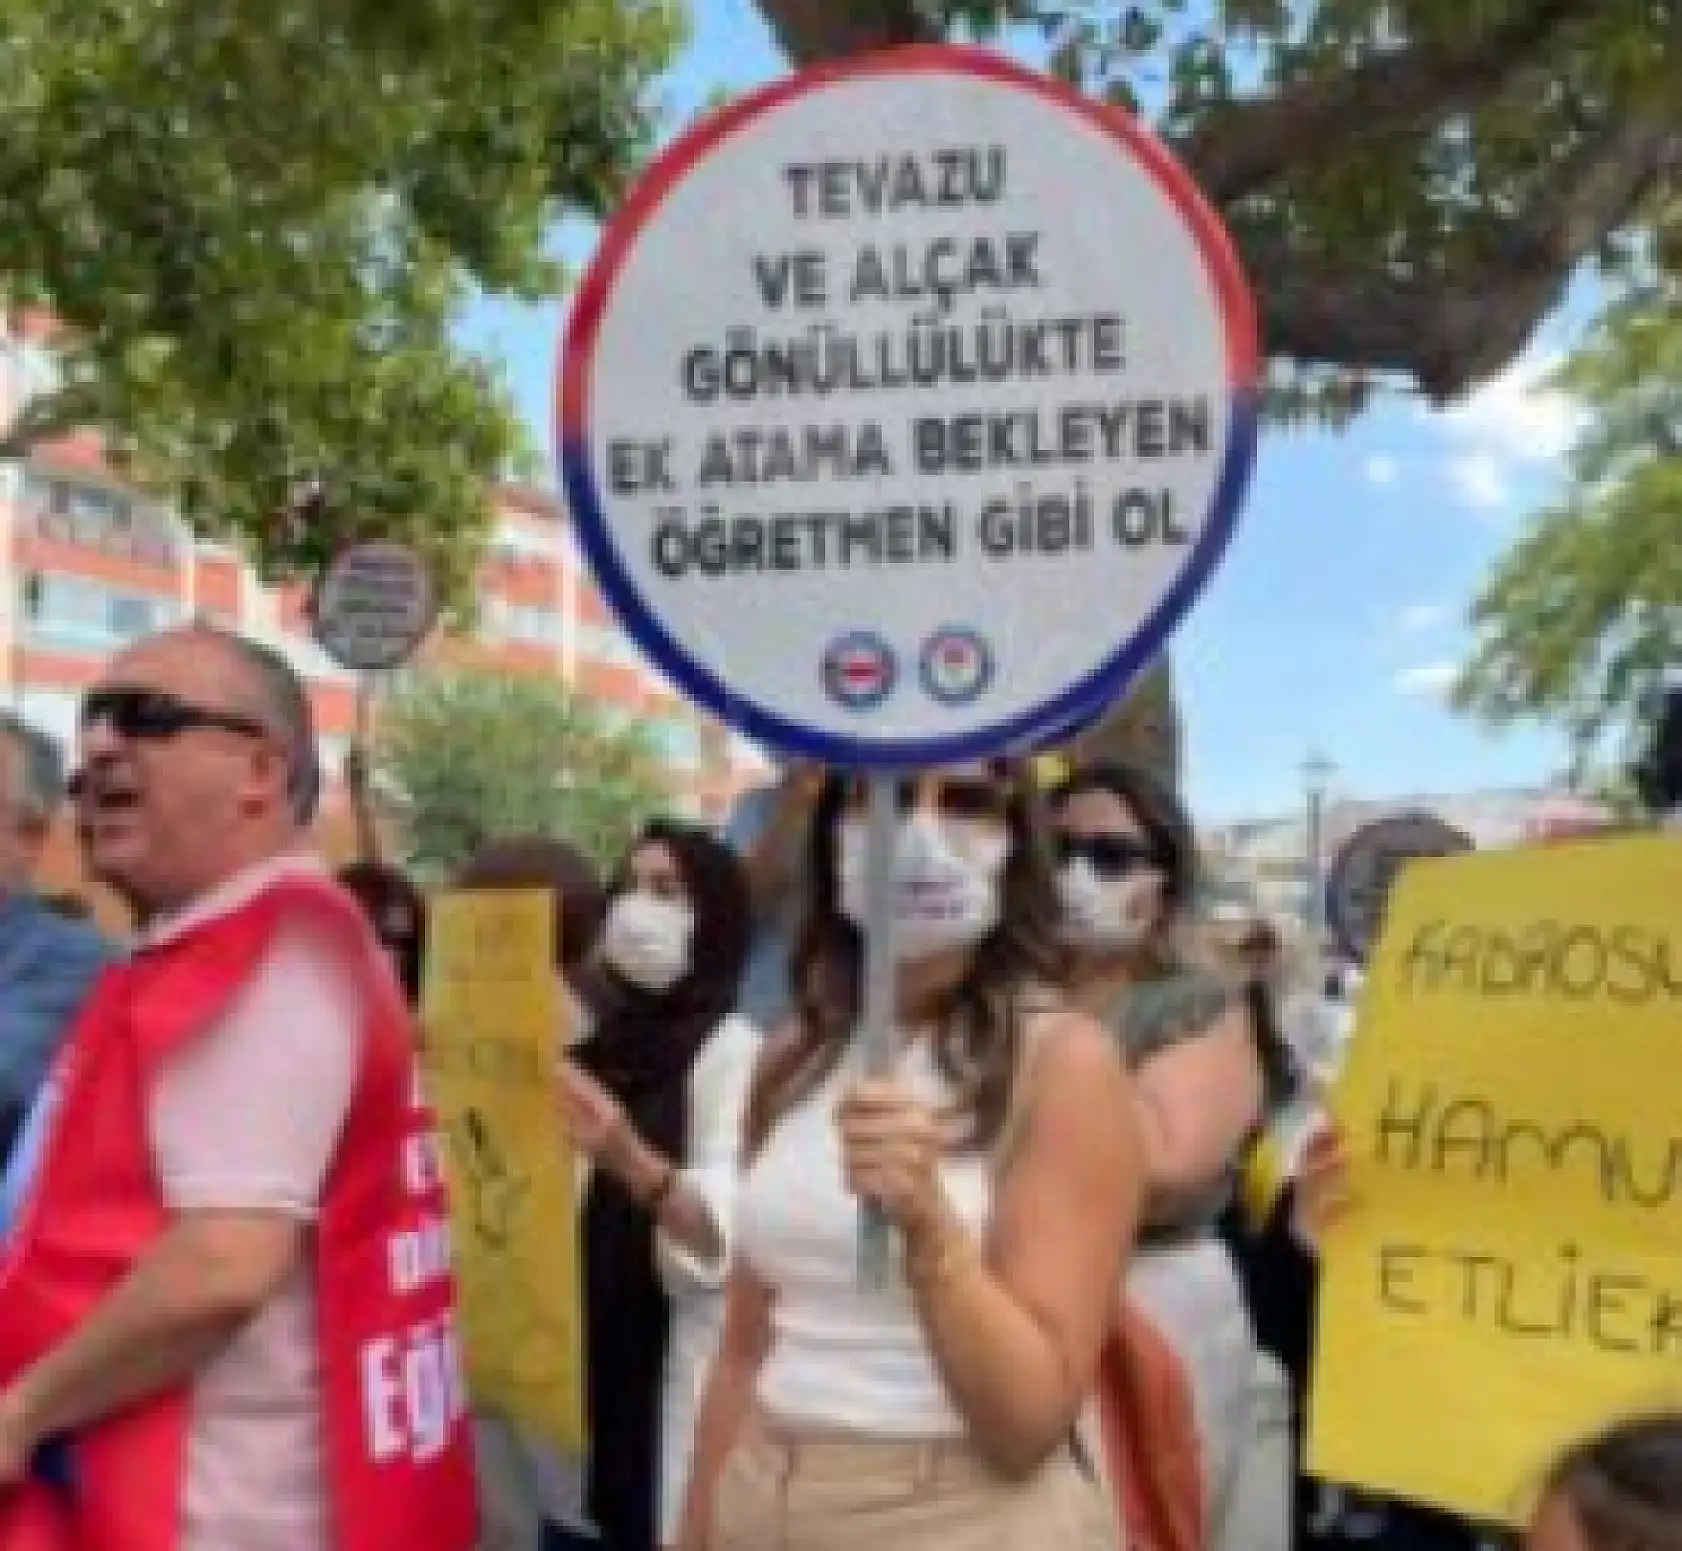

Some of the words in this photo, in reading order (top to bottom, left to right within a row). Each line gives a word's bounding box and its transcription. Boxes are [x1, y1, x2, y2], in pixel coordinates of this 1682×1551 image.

[785, 146, 1006, 219] TEVAZU
[754, 253, 826, 308] VE
[849, 232, 1041, 312] ALÇAK
[682, 307, 1126, 403] GÖNÜLLÜLÜKTE
[608, 440, 676, 493] EK
[699, 420, 890, 487] ATAMA
[914, 400, 1209, 475] BEKLEYEN
[651, 504, 956, 577] ÖĞRETMEN
[977, 484, 1092, 557] GİBİ
[1113, 489, 1190, 545] OL
